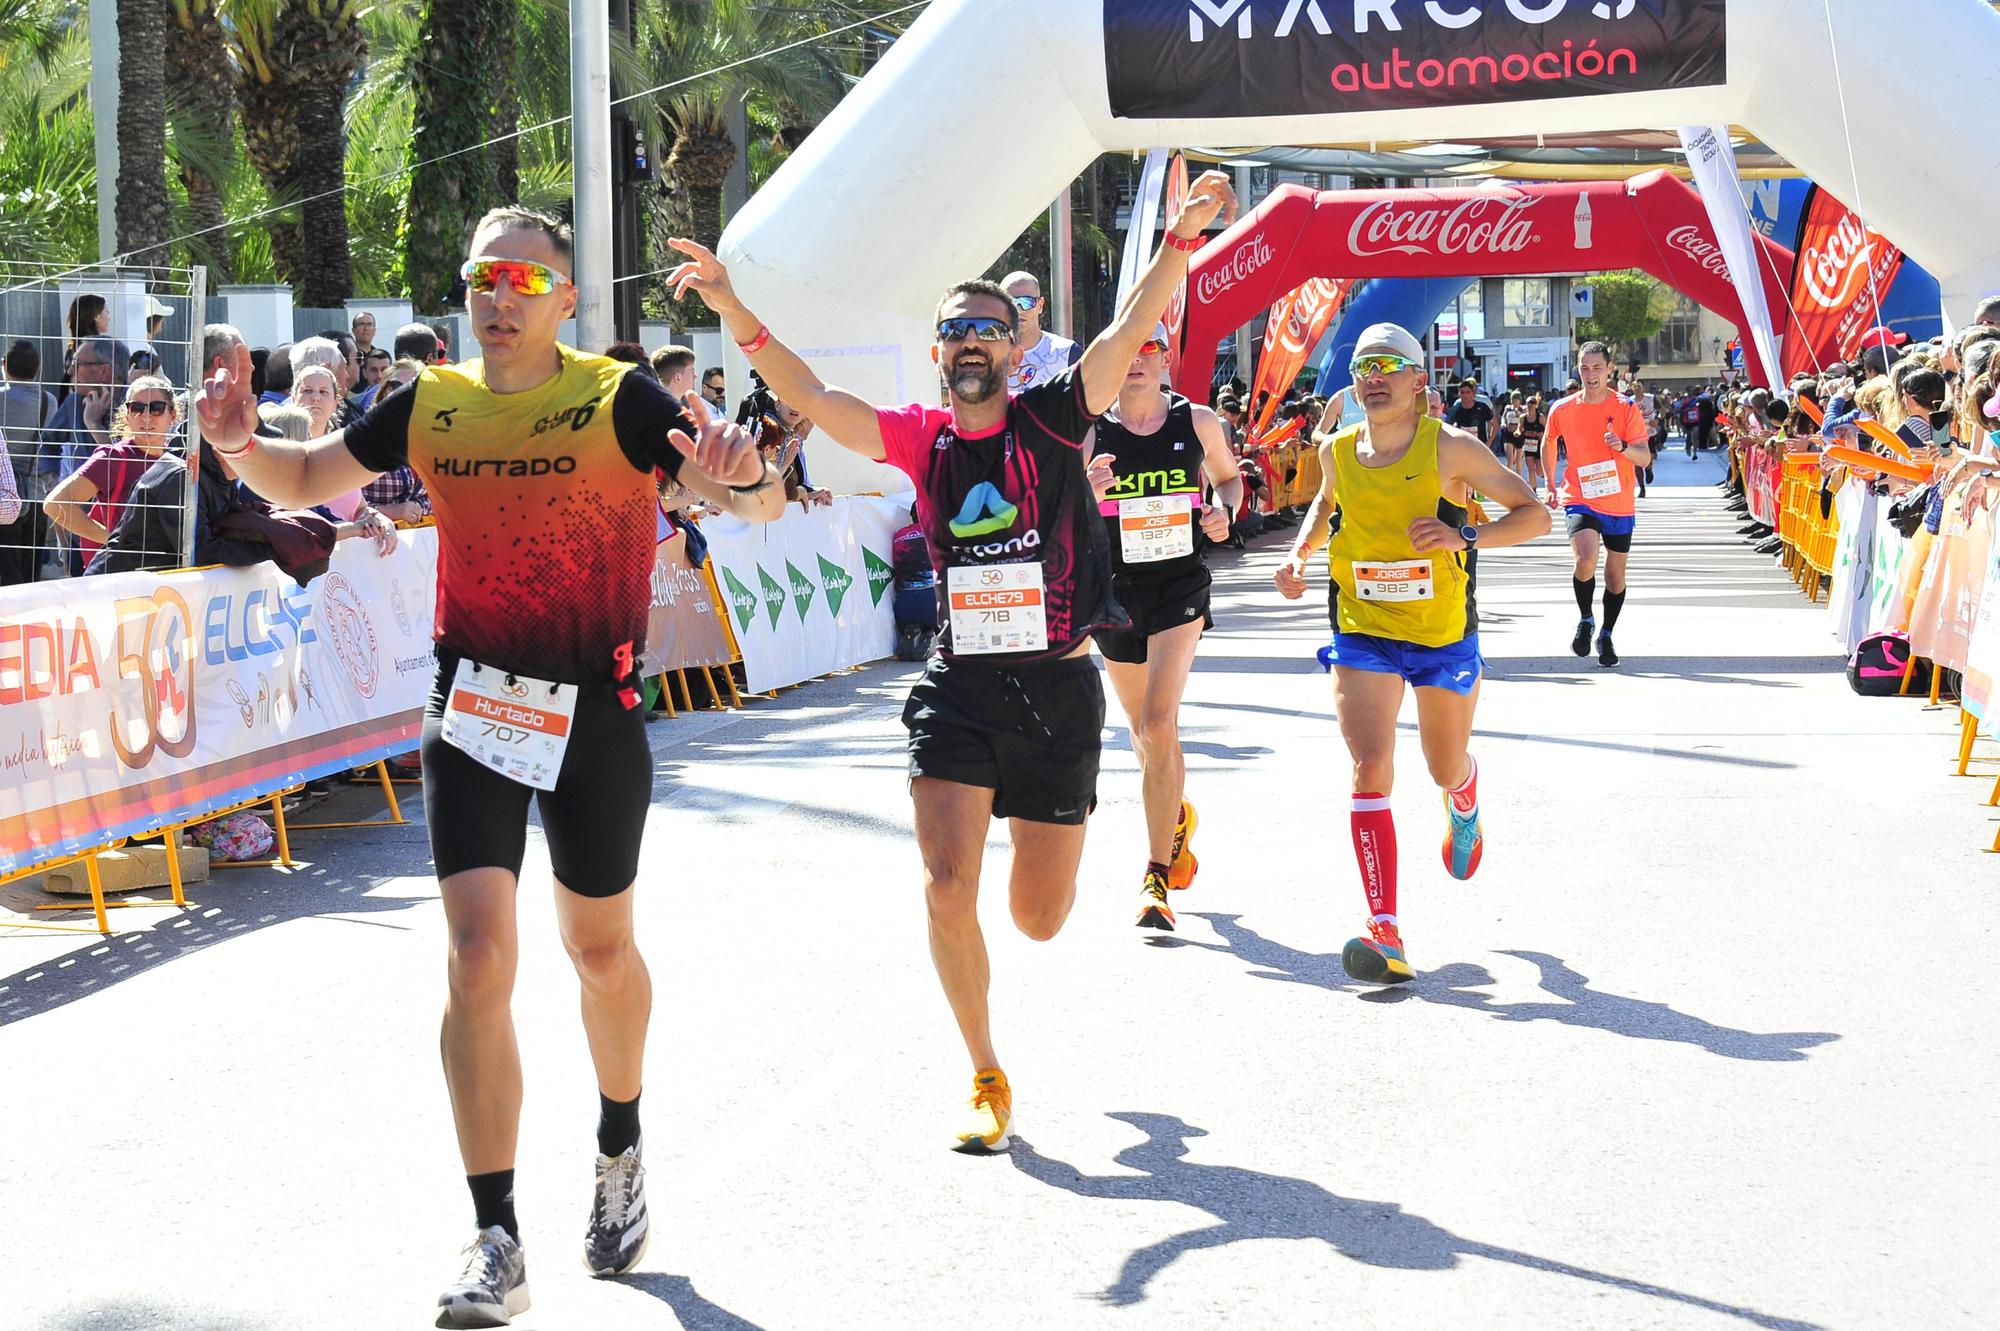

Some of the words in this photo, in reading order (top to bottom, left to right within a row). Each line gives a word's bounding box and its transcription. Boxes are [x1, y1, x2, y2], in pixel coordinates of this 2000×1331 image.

[1331, 39, 1637, 92] automoción
[1665, 225, 1734, 286] Coca-Co
[1143, 516, 1169, 528] JOSE
[1140, 528, 1173, 541] 1327
[1374, 569, 1411, 579] JORGE
[1377, 583, 1409, 593] 982
[965, 591, 1024, 606] ELCHE79
[979, 610, 1010, 623] 718
[205, 584, 318, 667] ELCHE
[475, 697, 545, 728] Hurtado
[481, 721, 530, 745] 707
